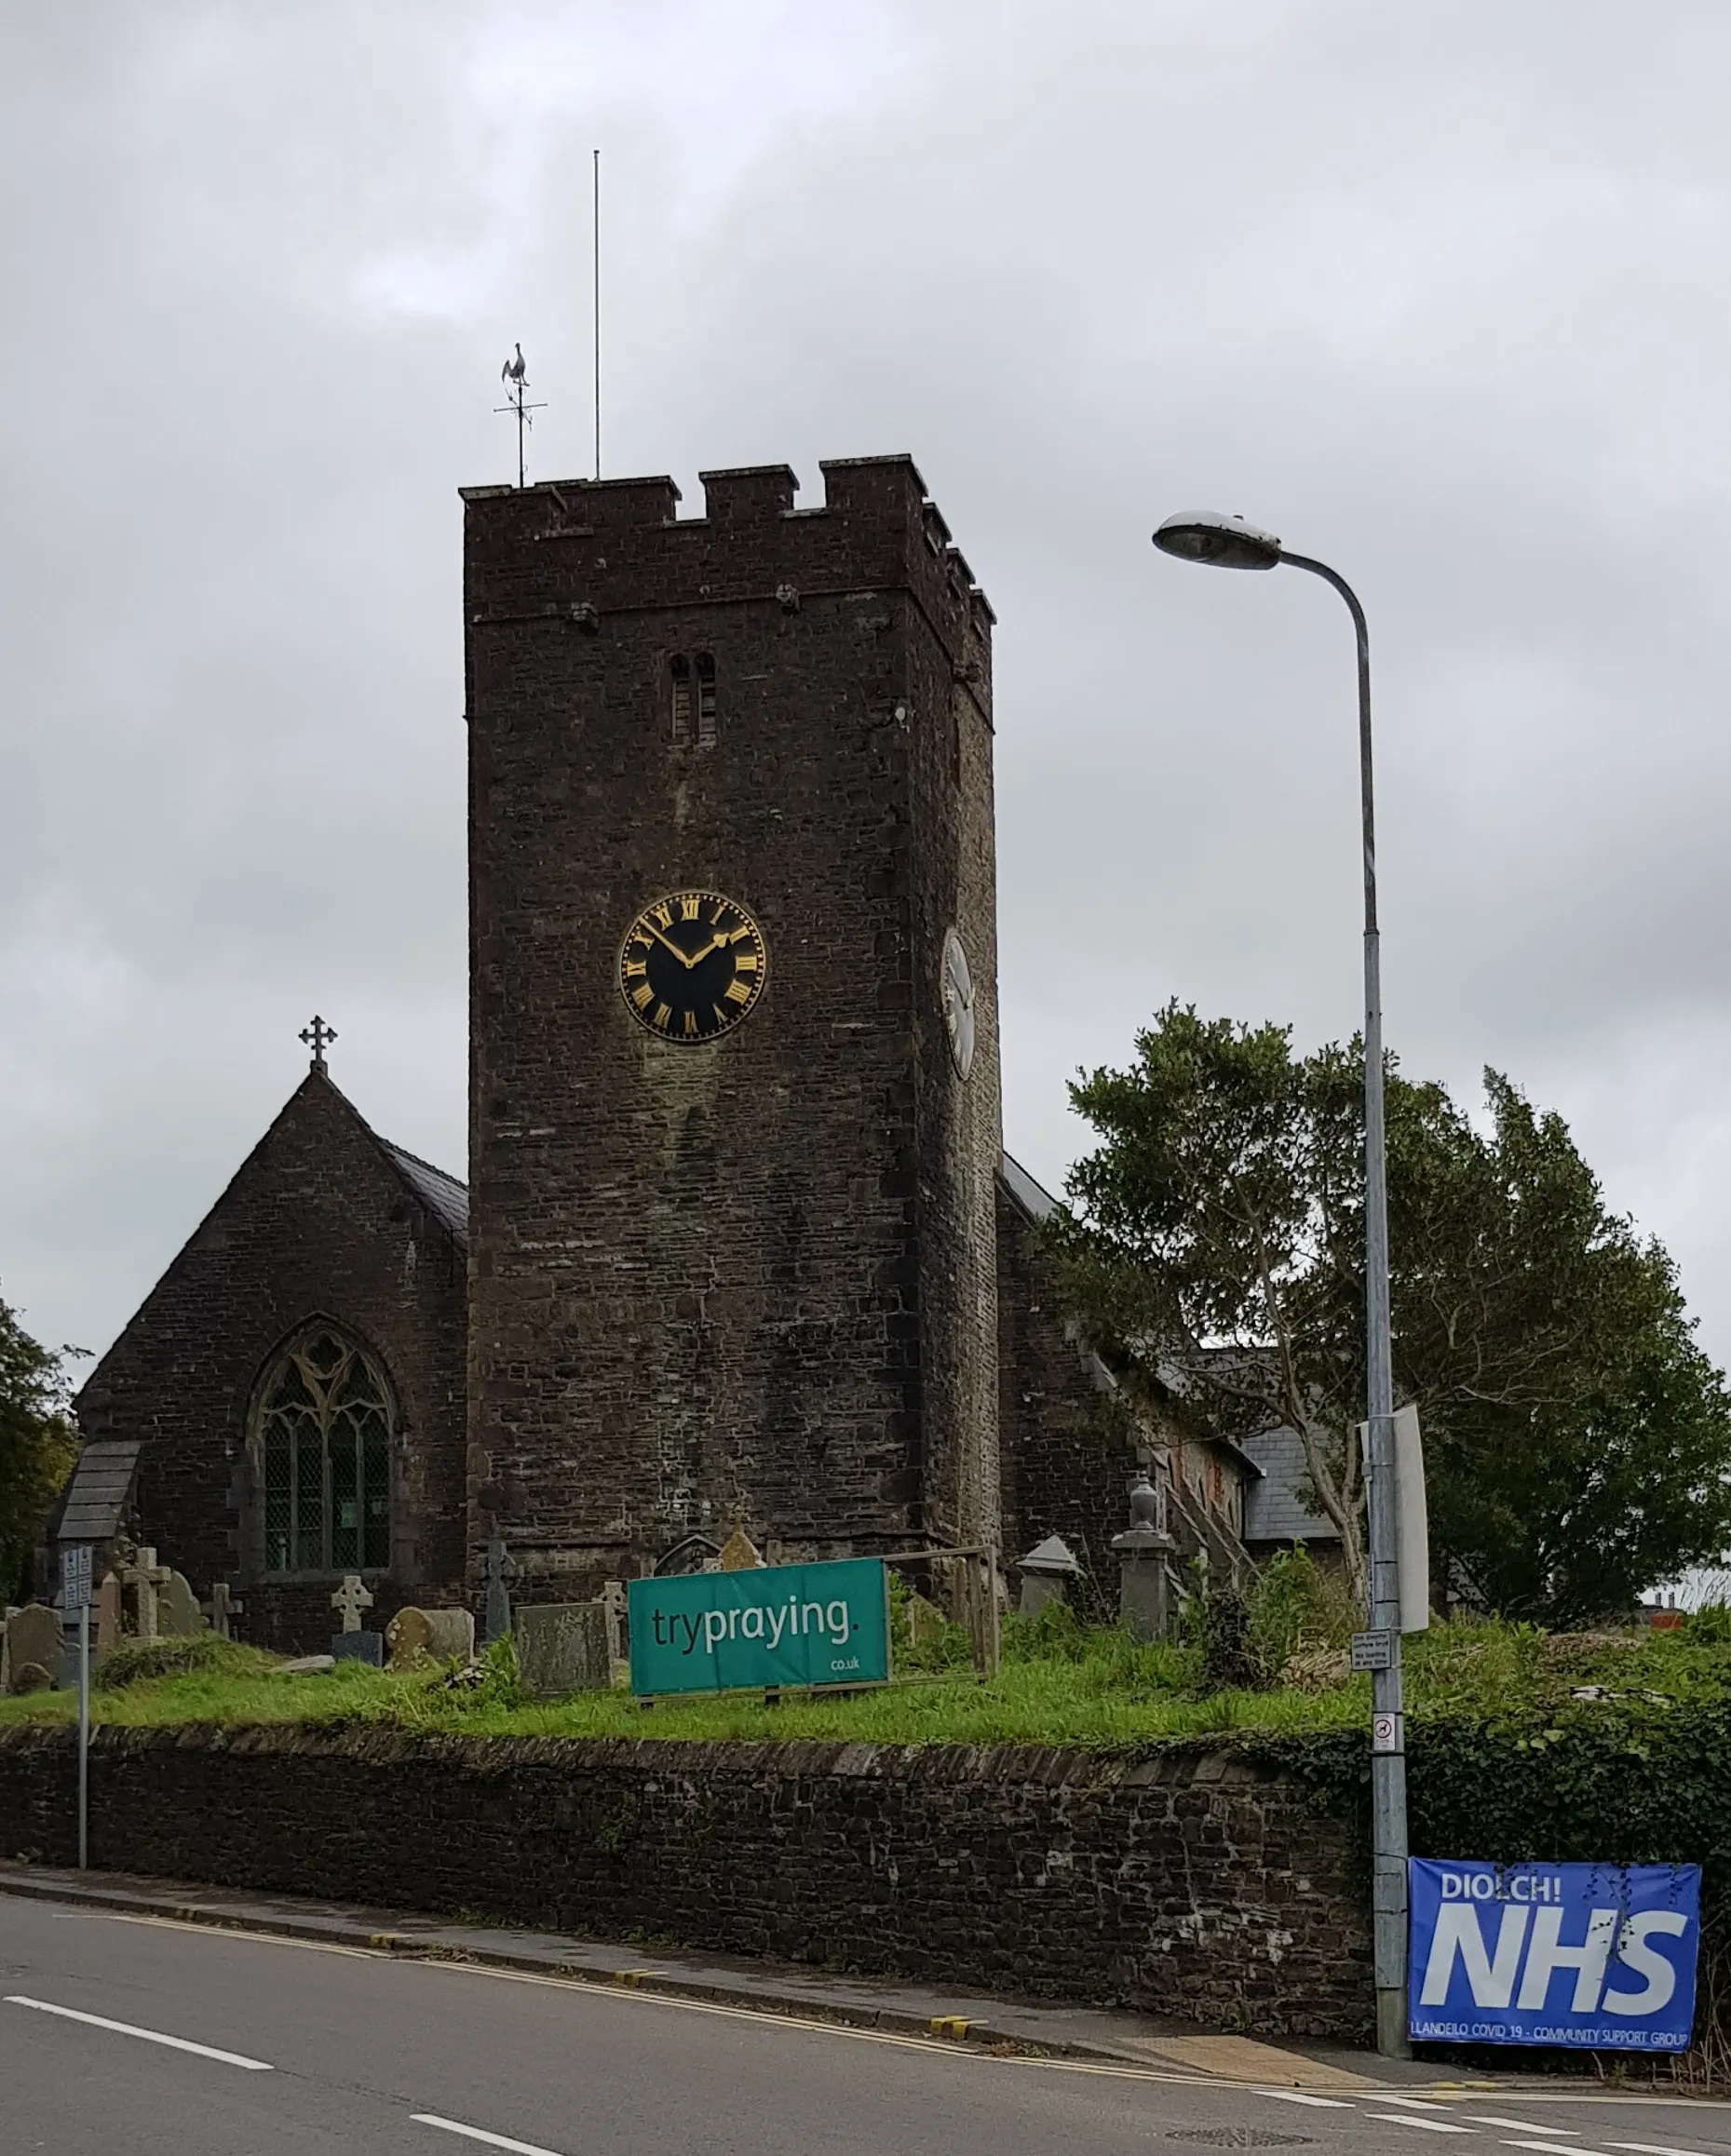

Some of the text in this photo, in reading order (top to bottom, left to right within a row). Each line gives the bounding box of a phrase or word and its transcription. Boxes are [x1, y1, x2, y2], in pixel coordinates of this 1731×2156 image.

[655, 905, 674, 931] XI
[682, 899, 700, 921] XII
[710, 906, 725, 925] I
[728, 925, 751, 945] II
[735, 956, 757, 973] III
[724, 979, 752, 1005] IIII
[712, 1004, 728, 1024] V
[830, 1655, 860, 1672] co.uk
[1441, 1872, 1562, 1903] DIOLCH!
[1419, 1902, 1688, 2016] NHS
[1411, 2021, 1468, 2036] LLANDEILO
[1472, 2024, 1506, 2038] COVID
[1509, 2025, 1522, 2039] 19
[1534, 2026, 1599, 2043] COMMUNITY
[1602, 2029, 1648, 2044] SUPPORT
[1650, 2031, 1689, 2047] GROUP
